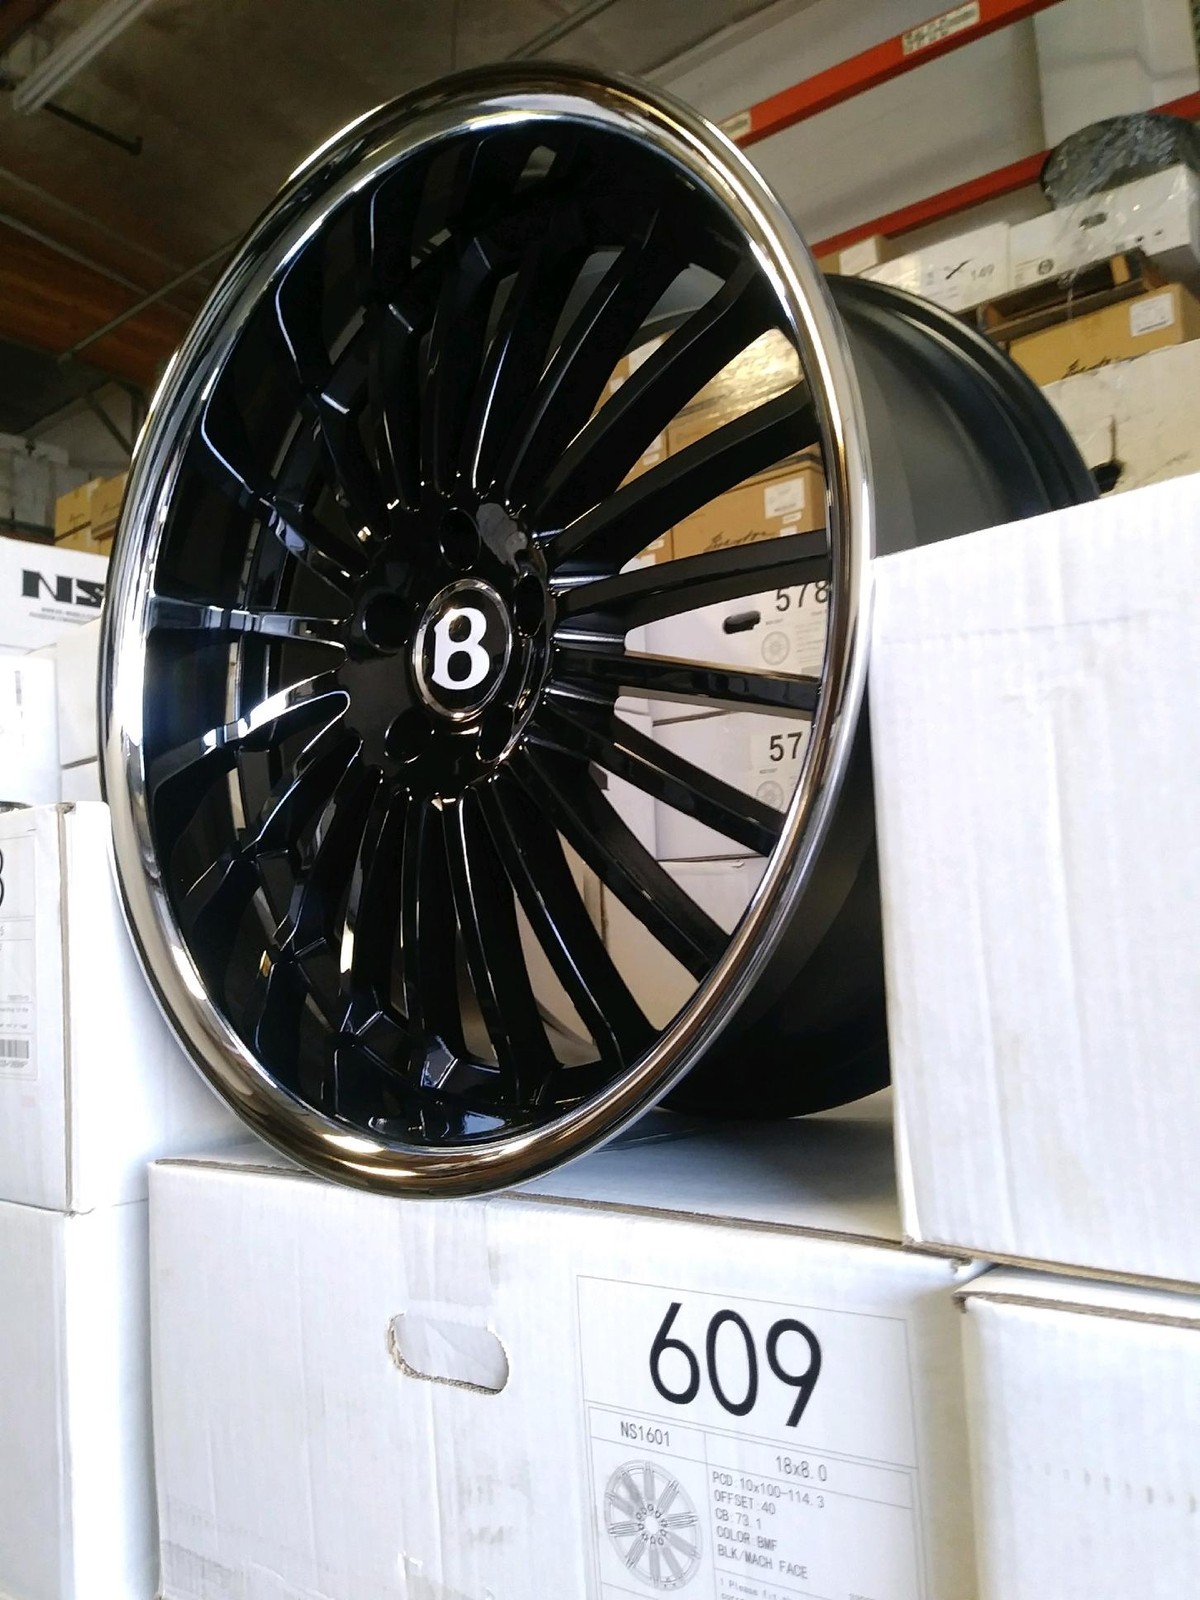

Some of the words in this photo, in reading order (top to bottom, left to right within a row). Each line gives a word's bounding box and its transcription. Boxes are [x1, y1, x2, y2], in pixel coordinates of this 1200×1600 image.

[22, 569, 104, 608] NS
[776, 580, 828, 611] 578
[431, 607, 490, 690] B
[650, 1302, 822, 1427] 609
[620, 1421, 669, 1447] NS1601
[776, 1455, 827, 1481] 18x8.0
[717, 1544, 773, 1569] BLK/MACH
[779, 1560, 809, 1580] FACE
